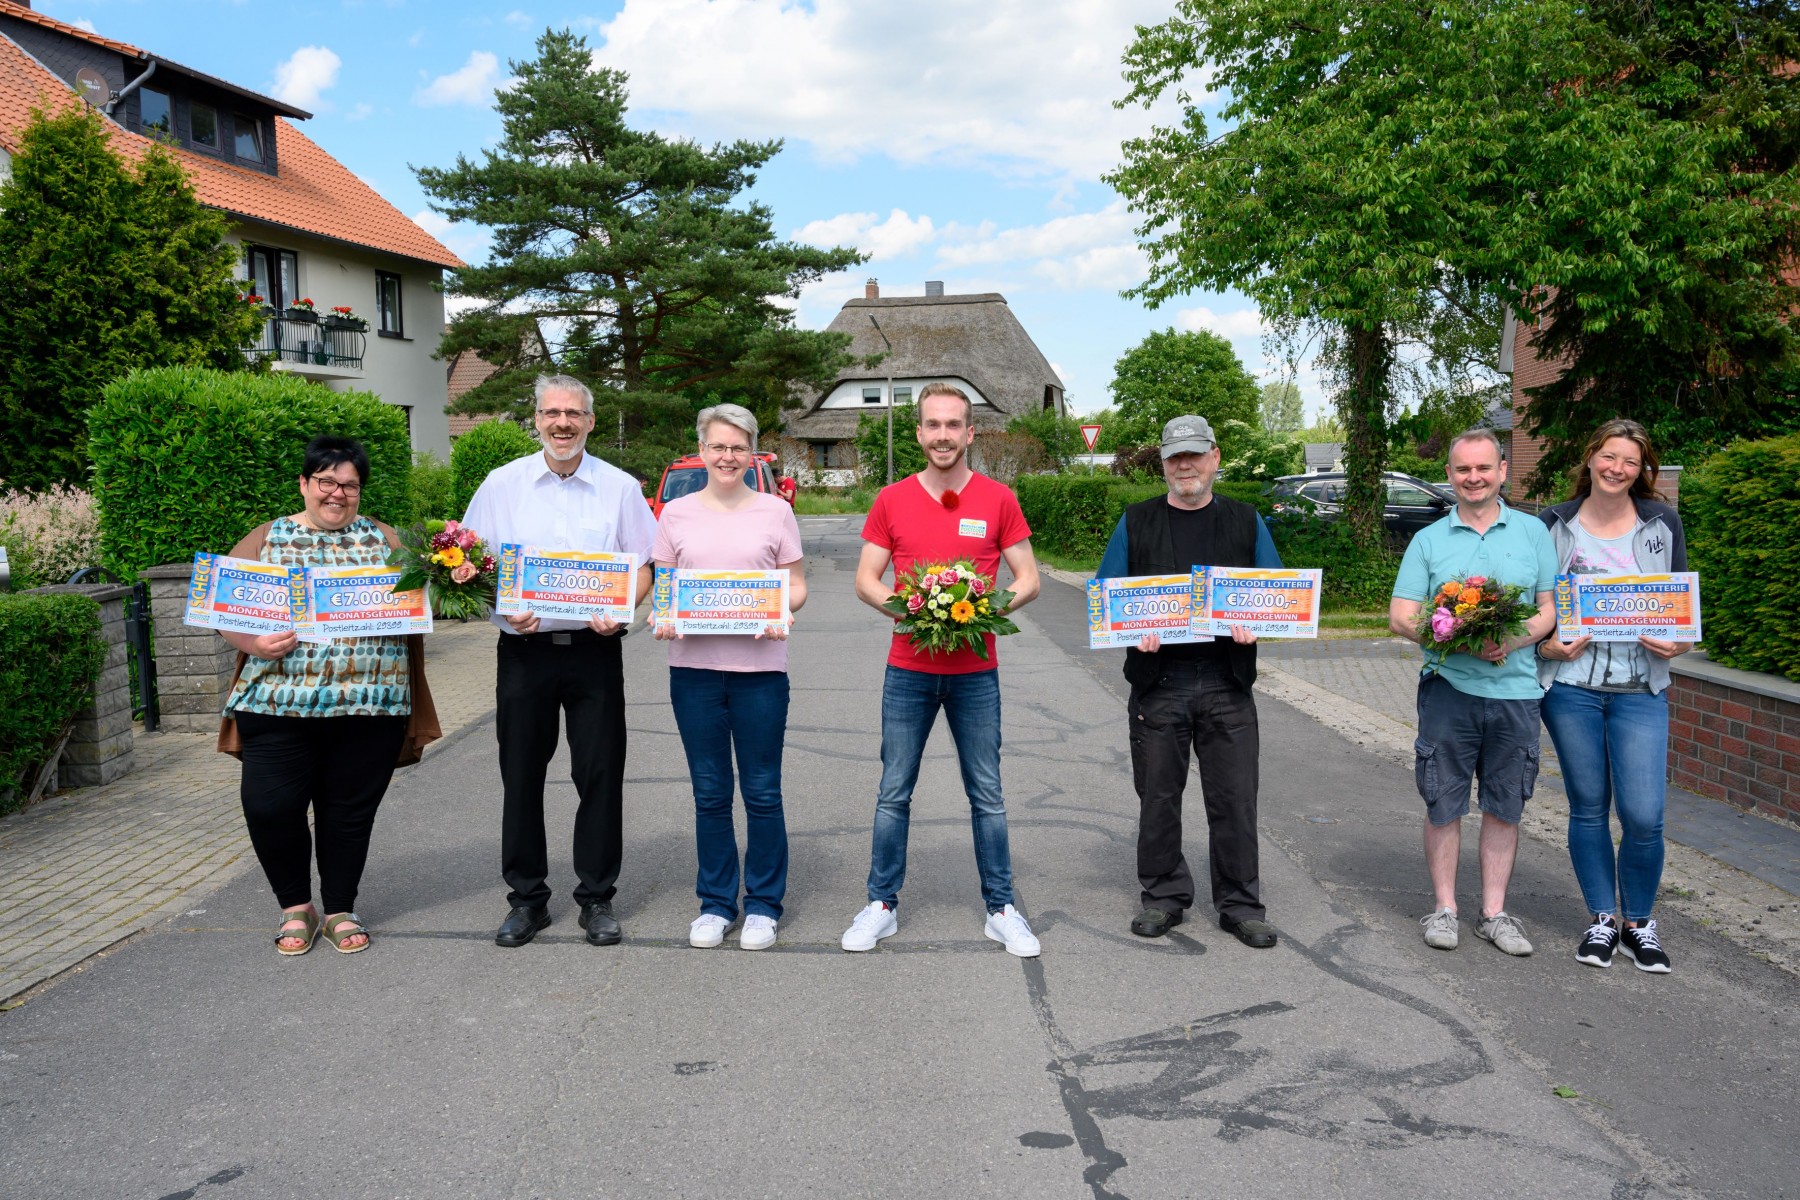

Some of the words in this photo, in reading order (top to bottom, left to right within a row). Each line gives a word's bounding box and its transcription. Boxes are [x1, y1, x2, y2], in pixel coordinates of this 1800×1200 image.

[526, 558, 579, 568] POSTCODE
[582, 562, 626, 572] LOTTERIE
[222, 569, 278, 584] POSTCODE
[500, 548, 516, 598] SCHECK
[190, 557, 212, 608] SCHECK
[317, 578, 372, 587] POSTCODE
[374, 576, 400, 585] LOTT
[538, 573, 614, 592] €7.000,-
[1216, 579, 1266, 588] POSTCODE
[1268, 580, 1311, 588] LOTTERIE
[1638, 584, 1686, 592] LOTTERIE
[232, 586, 290, 608] €7.00
[291, 572, 308, 622] SCHECK
[534, 592, 614, 604] MONATSGEWINN
[656, 571, 671, 618] SCHECK
[1111, 587, 1158, 597] POSTCODE
[1192, 570, 1206, 617] SCHECK
[692, 592, 766, 608] €7.000,-
[1089, 582, 1104, 631] SCHECK
[1226, 592, 1298, 609] €7.000,-
[1558, 580, 1572, 625] SCHECK
[1595, 598, 1674, 613] €7.000,-
[330, 610, 410, 620] MONATSGEWINN
[527, 602, 576, 614] Postleitzahl:
[579, 606, 605, 616] 29399
[1224, 612, 1298, 620] MONATSGEWINN
[218, 614, 270, 630] Postleitzahl:
[323, 623, 374, 632] Postleitzahl:
[376, 621, 402, 630] 29399
[682, 620, 732, 630] Postleitzahl:
[734, 622, 758, 630] 29399
[1122, 619, 1190, 630] MONATSGEWIN
[1266, 624, 1288, 632] 29399
[1162, 630, 1186, 638] 29399
[1588, 628, 1638, 636] Postleitzahl:
[1640, 628, 1668, 636] 29399
